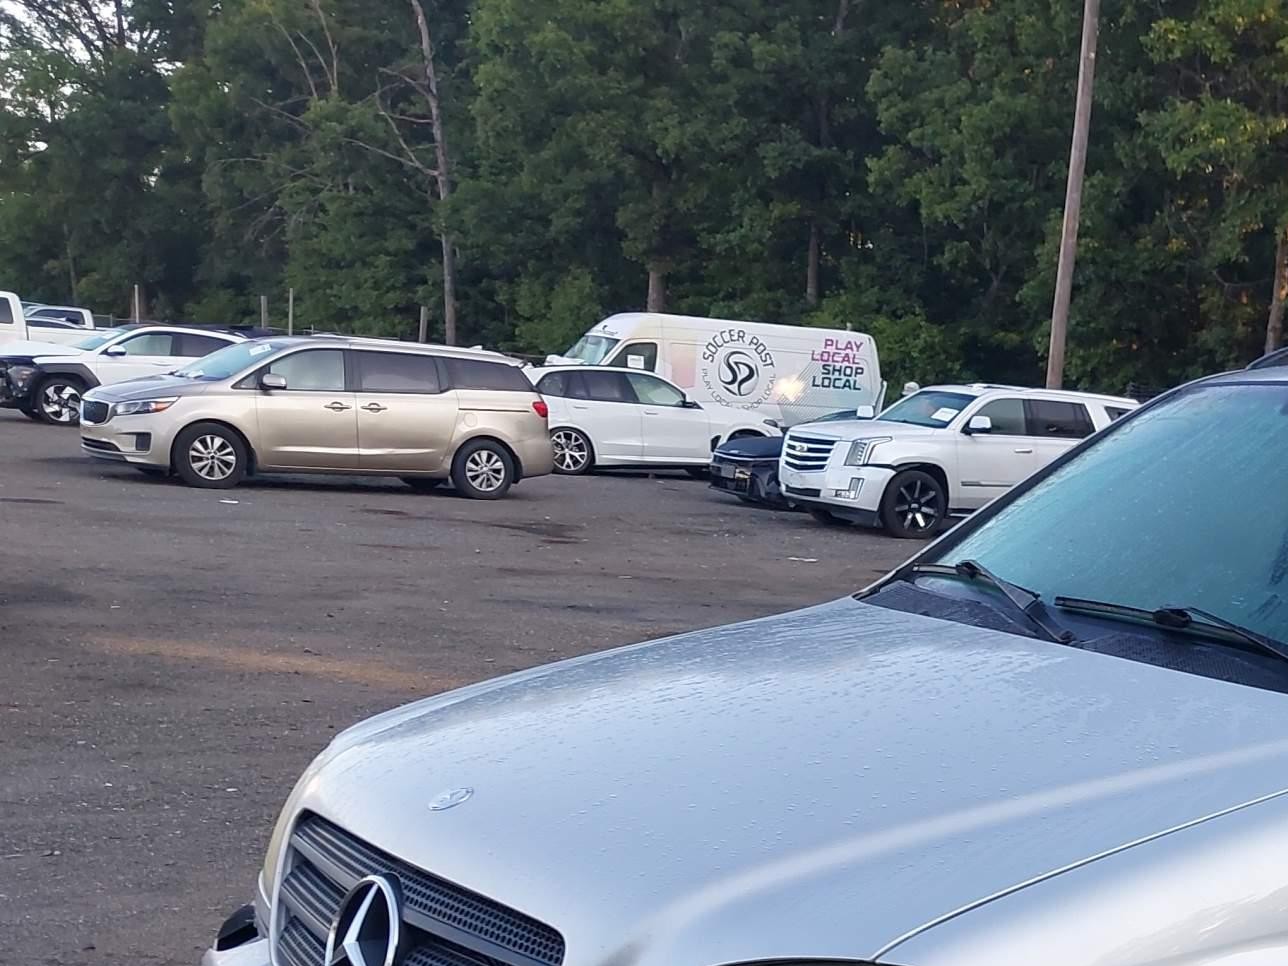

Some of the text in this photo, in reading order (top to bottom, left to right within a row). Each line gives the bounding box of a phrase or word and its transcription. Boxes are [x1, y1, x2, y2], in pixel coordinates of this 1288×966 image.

[702, 328, 775, 369] SOCCER POST
[824, 338, 864, 353] PLAY
[811, 350, 860, 365] LOCAL
[821, 364, 864, 378] SHOP
[812, 376, 861, 391] LOCAL
